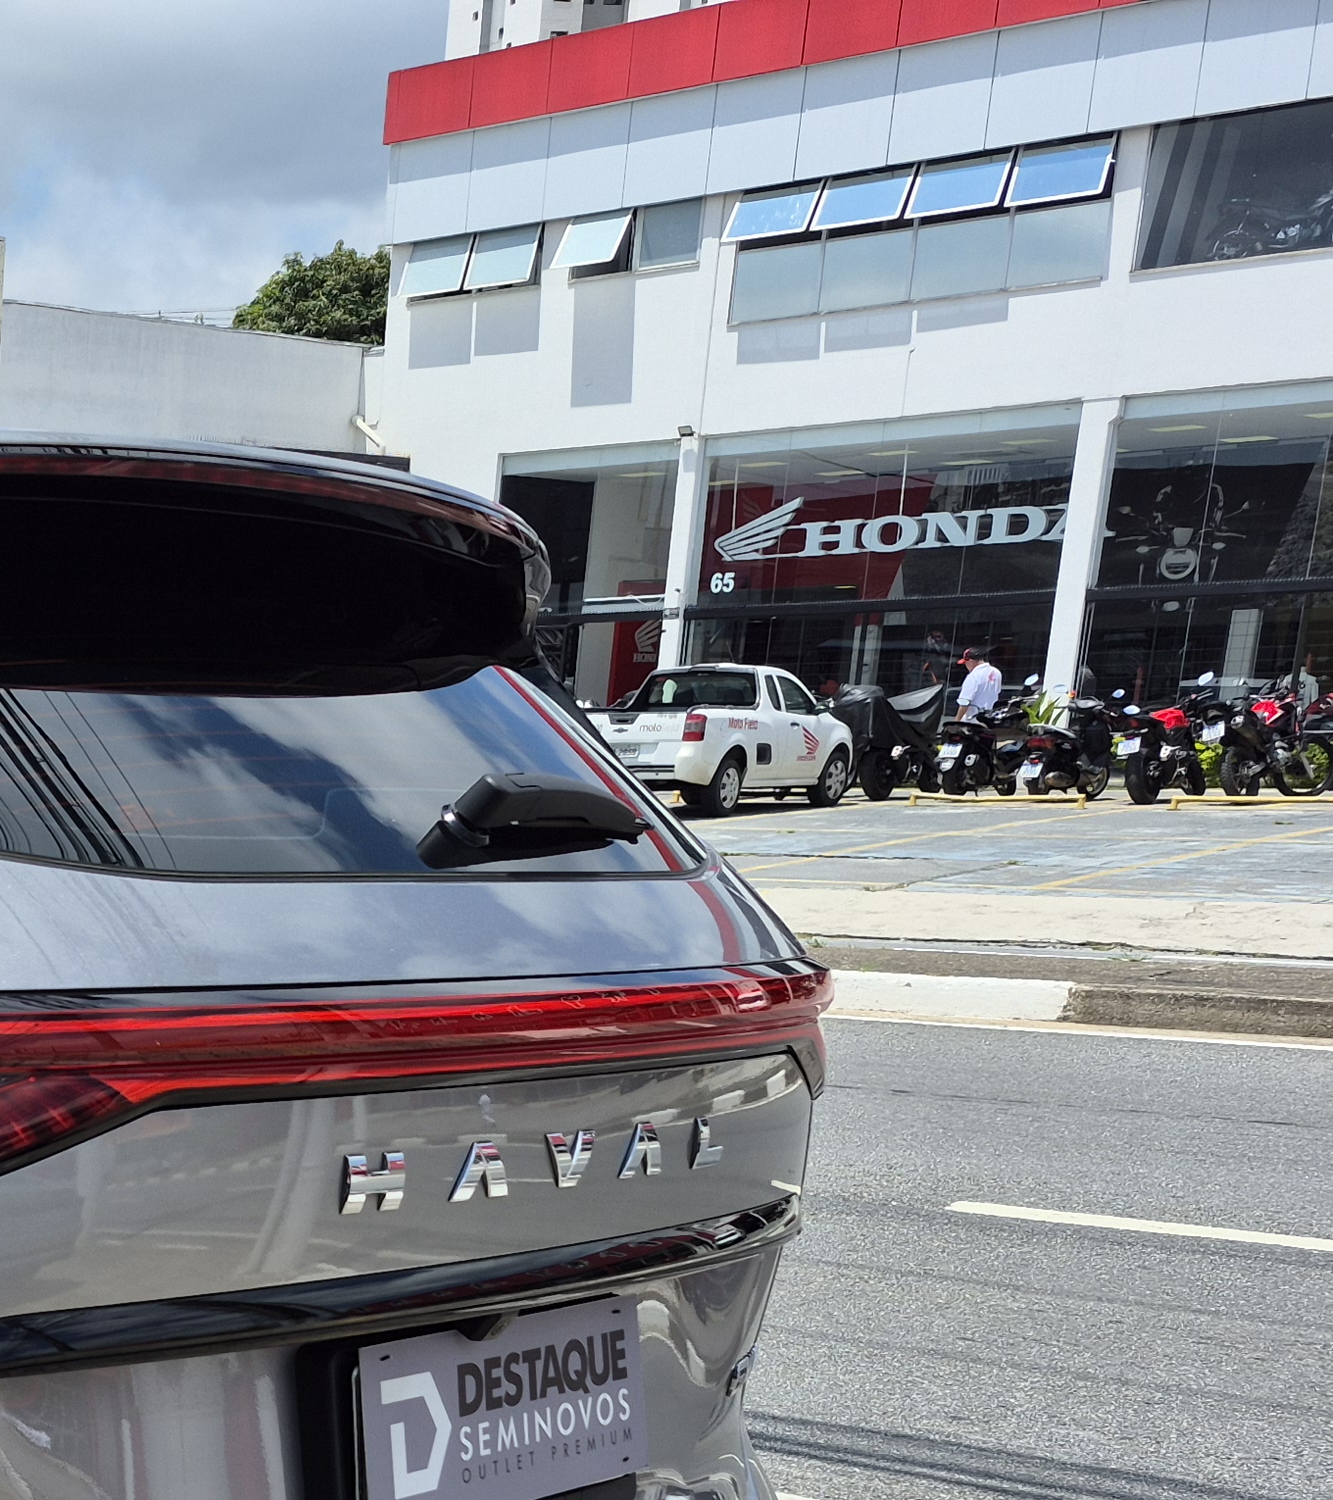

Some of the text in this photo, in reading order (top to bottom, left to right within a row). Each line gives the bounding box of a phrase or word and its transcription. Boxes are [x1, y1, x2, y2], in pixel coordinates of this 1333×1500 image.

[710, 572, 735, 594] 65
[728, 717, 743, 730] Moto
[339, 1115, 724, 1215] HAVAL
[456, 1329, 628, 1418] DESTAQUE
[459, 1387, 631, 1461] SEMINOVOS
[461, 1427, 633, 1484] OUTLET PREMIUM
